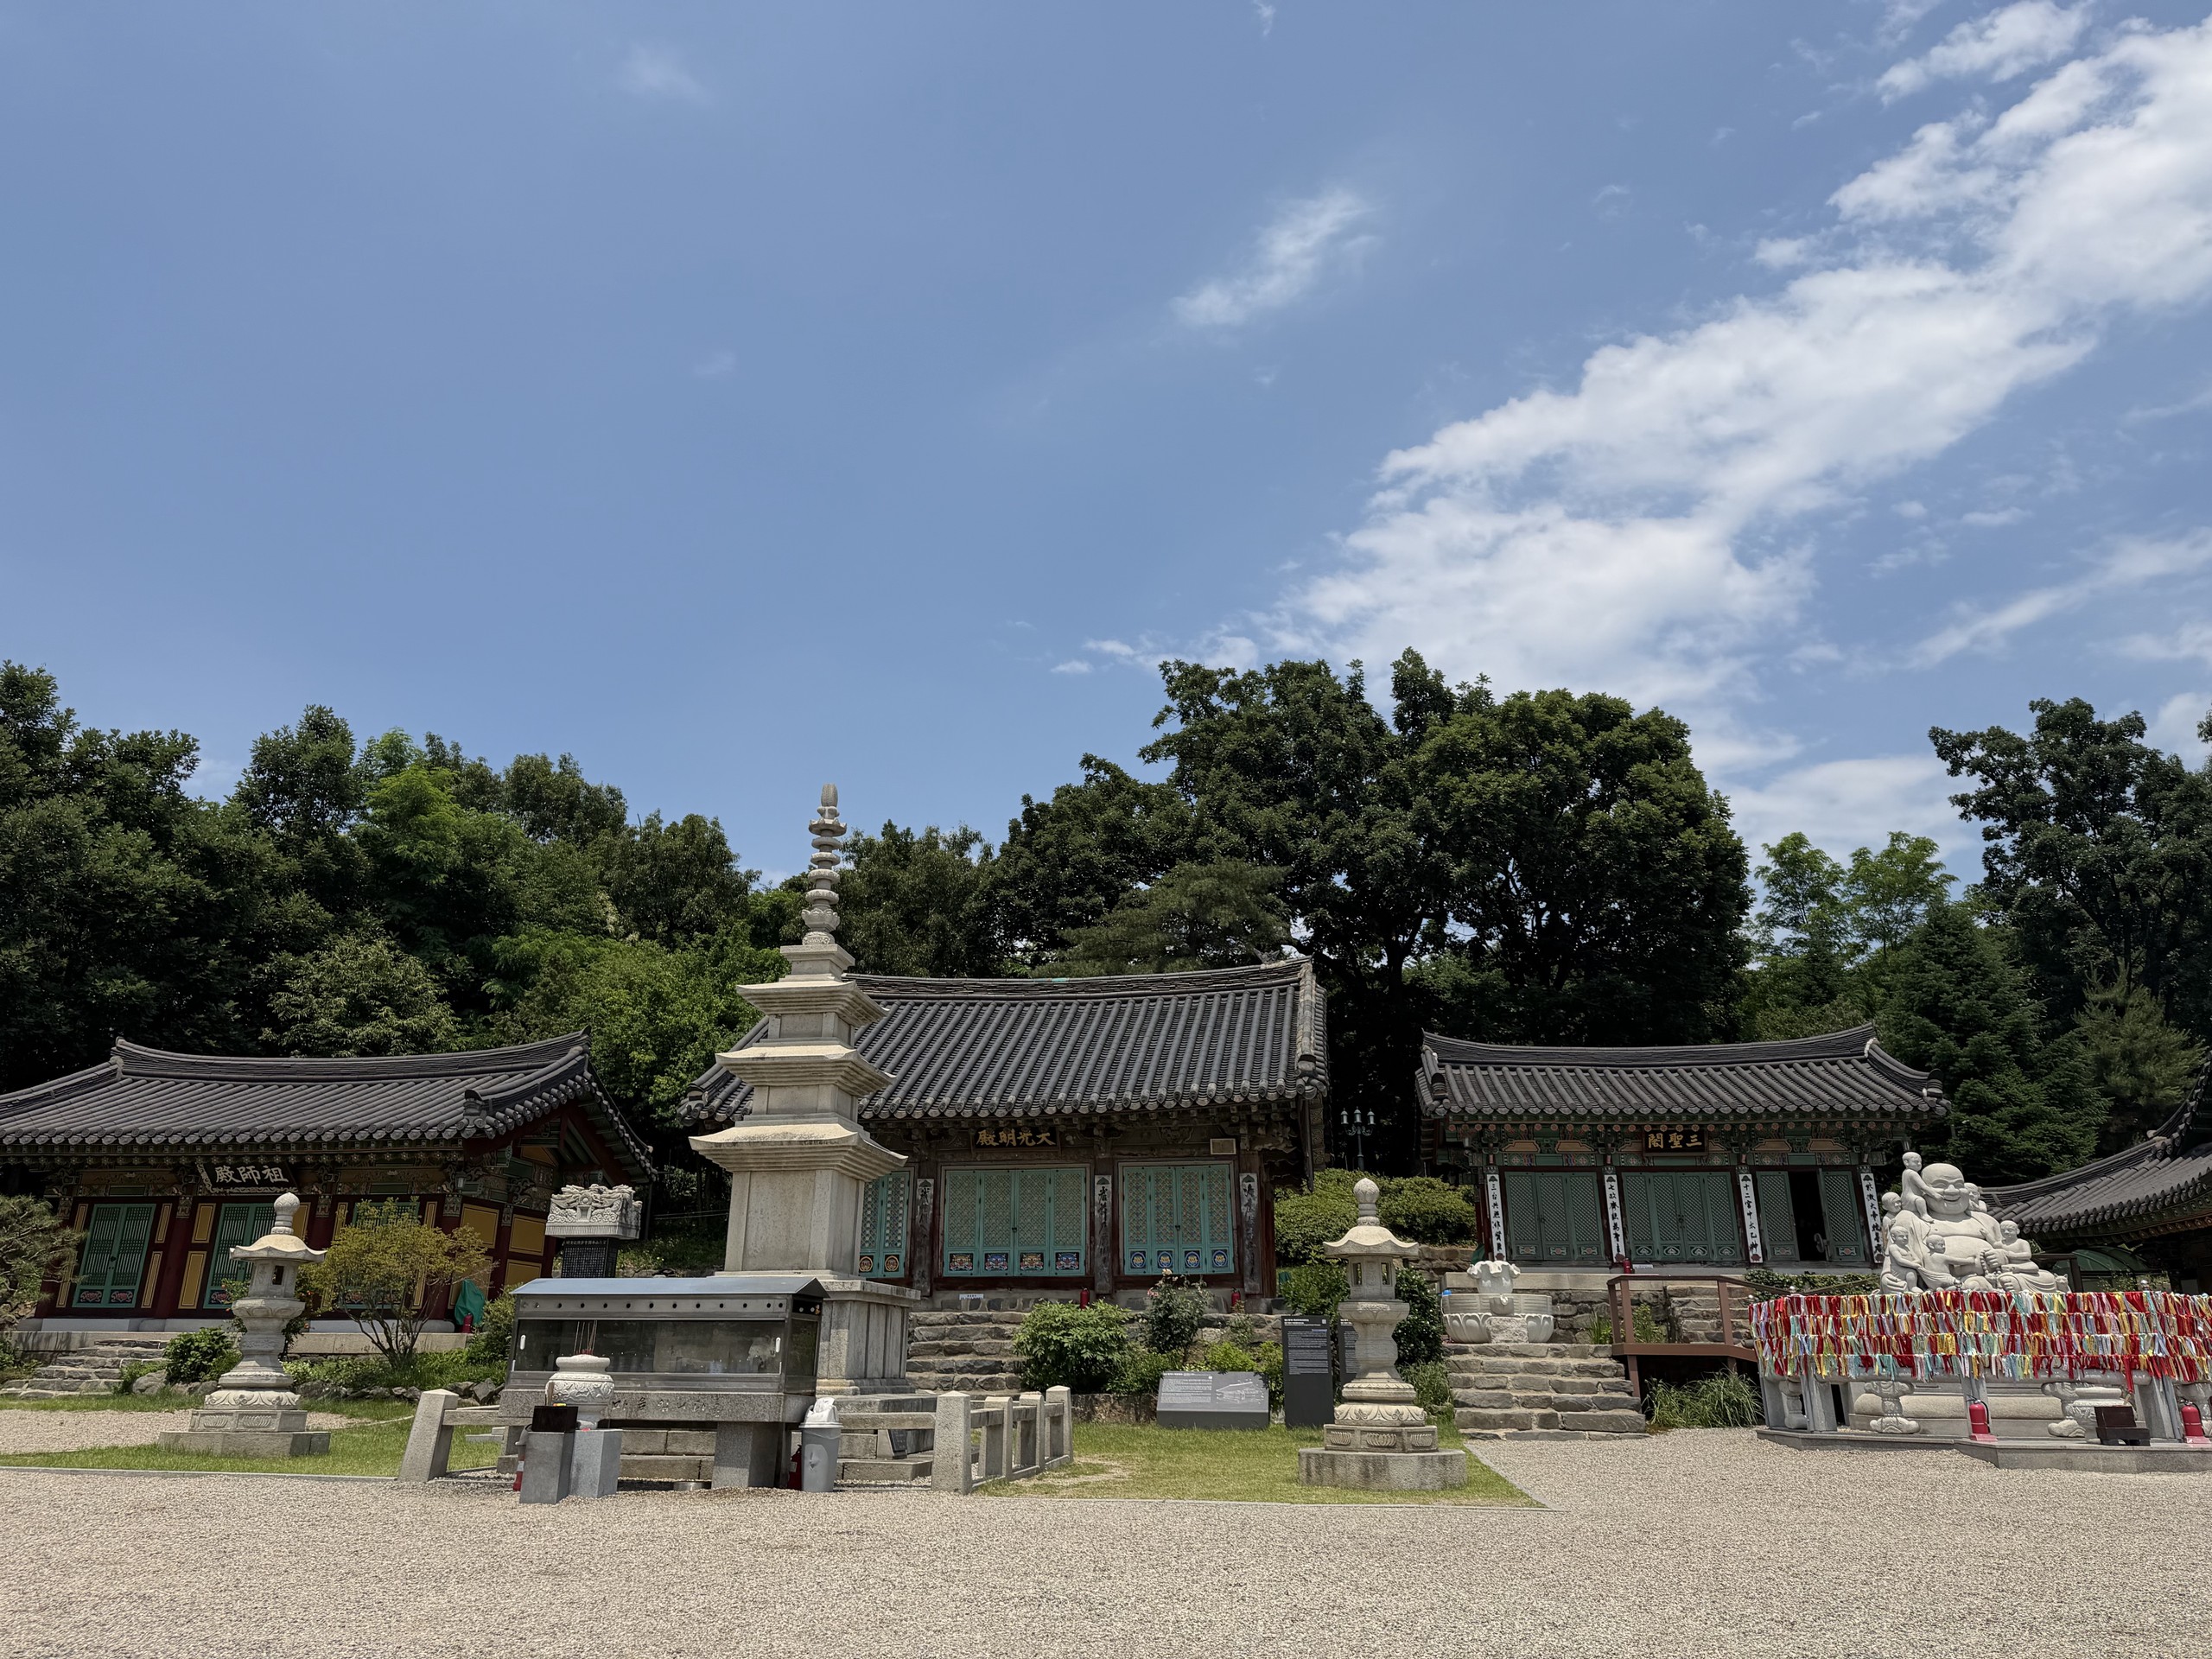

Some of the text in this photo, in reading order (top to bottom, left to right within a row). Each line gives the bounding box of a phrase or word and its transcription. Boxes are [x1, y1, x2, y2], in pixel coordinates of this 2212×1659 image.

[976, 1128, 1056, 1147] 大光明殿
[1648, 1133, 1702, 1149] 三聖閣
[215, 1165, 289, 1185] 祖師殿
